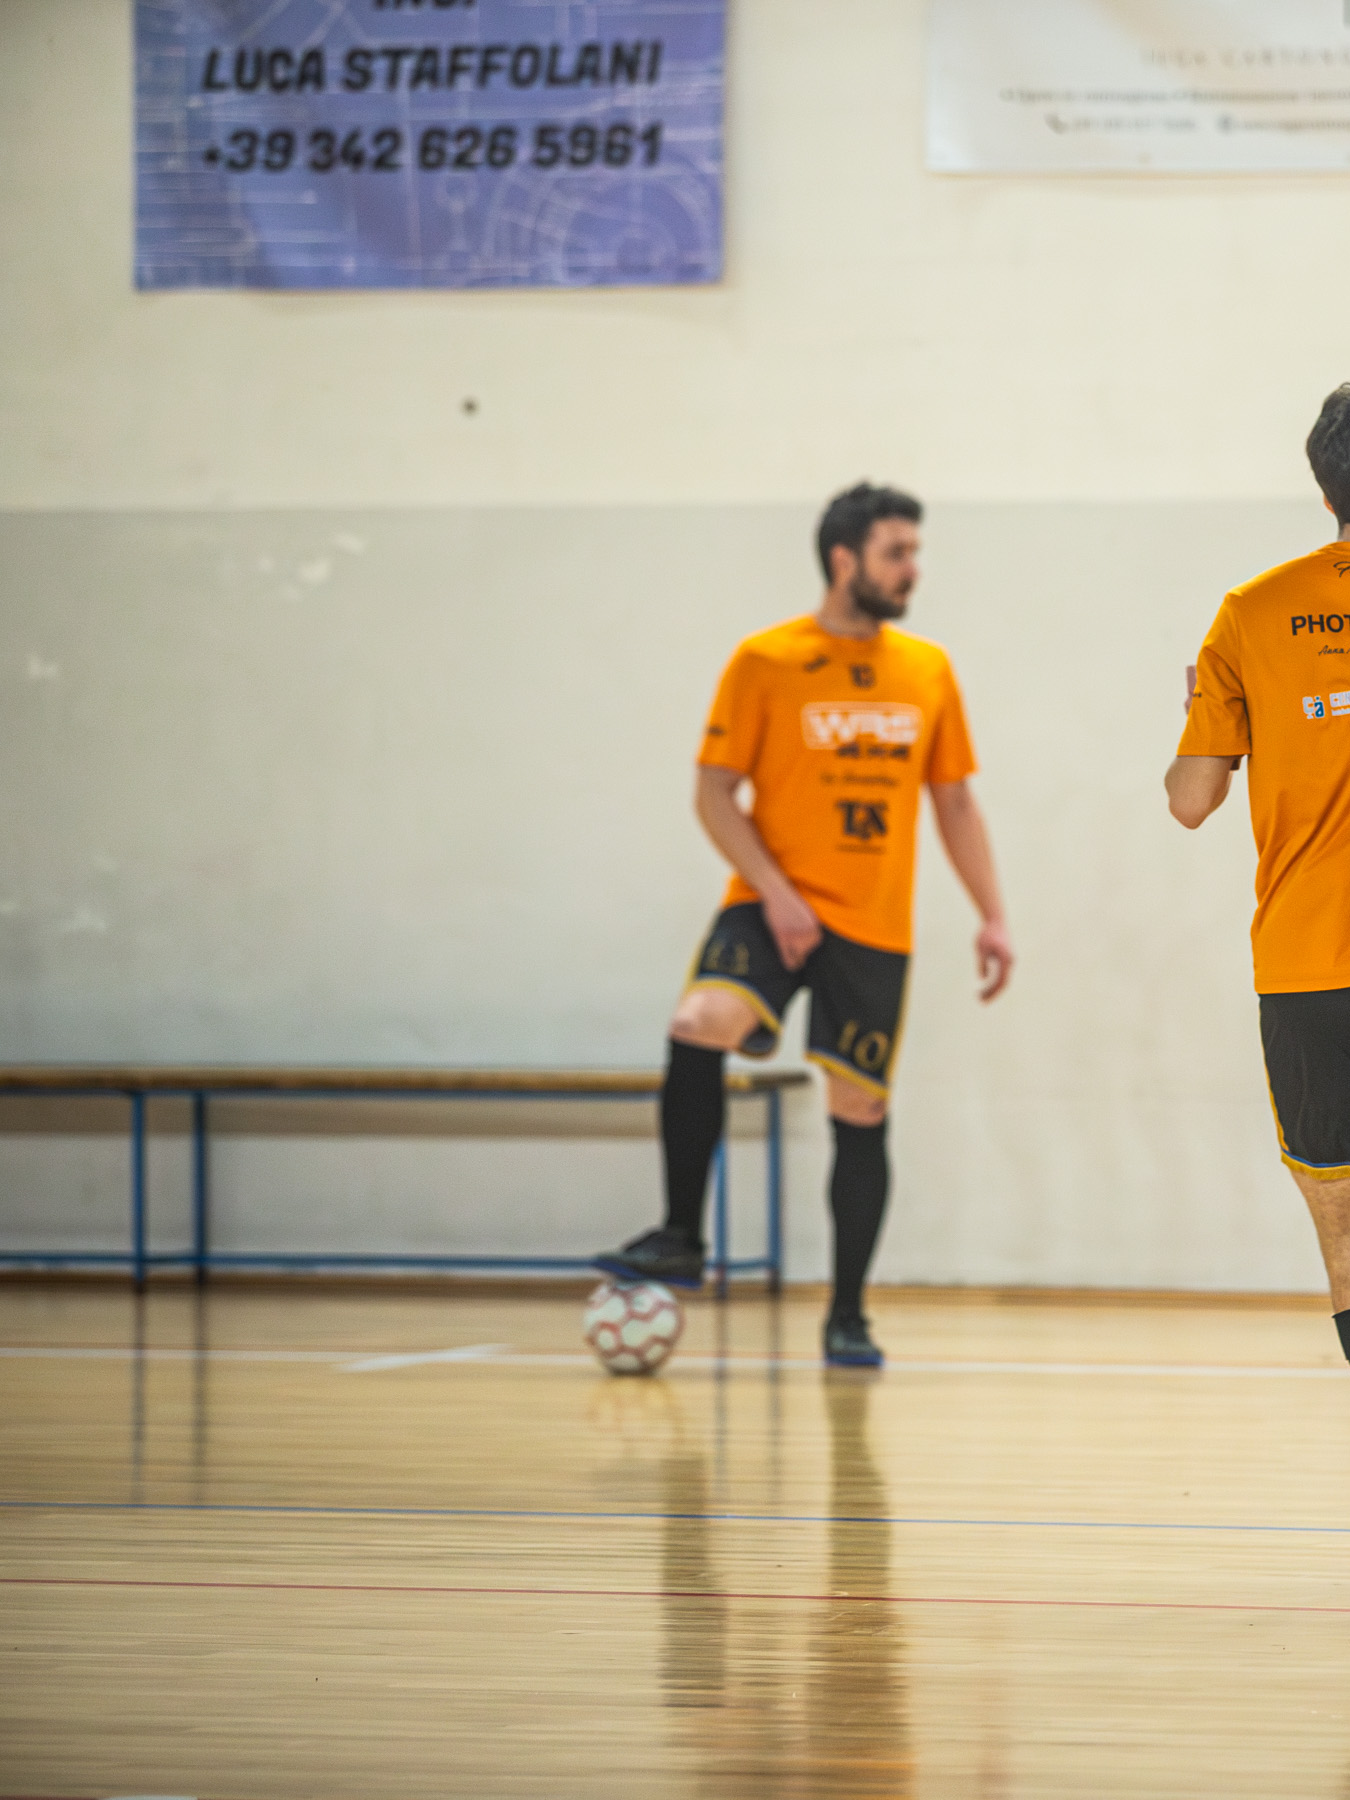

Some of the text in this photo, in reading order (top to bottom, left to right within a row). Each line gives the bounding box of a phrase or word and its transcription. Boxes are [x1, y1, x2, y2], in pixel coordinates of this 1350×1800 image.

[202, 41, 662, 92] LUCA STAFFOLANI
[201, 120, 664, 173] +39 342 626 5961
[838, 1019, 890, 1071] 10
